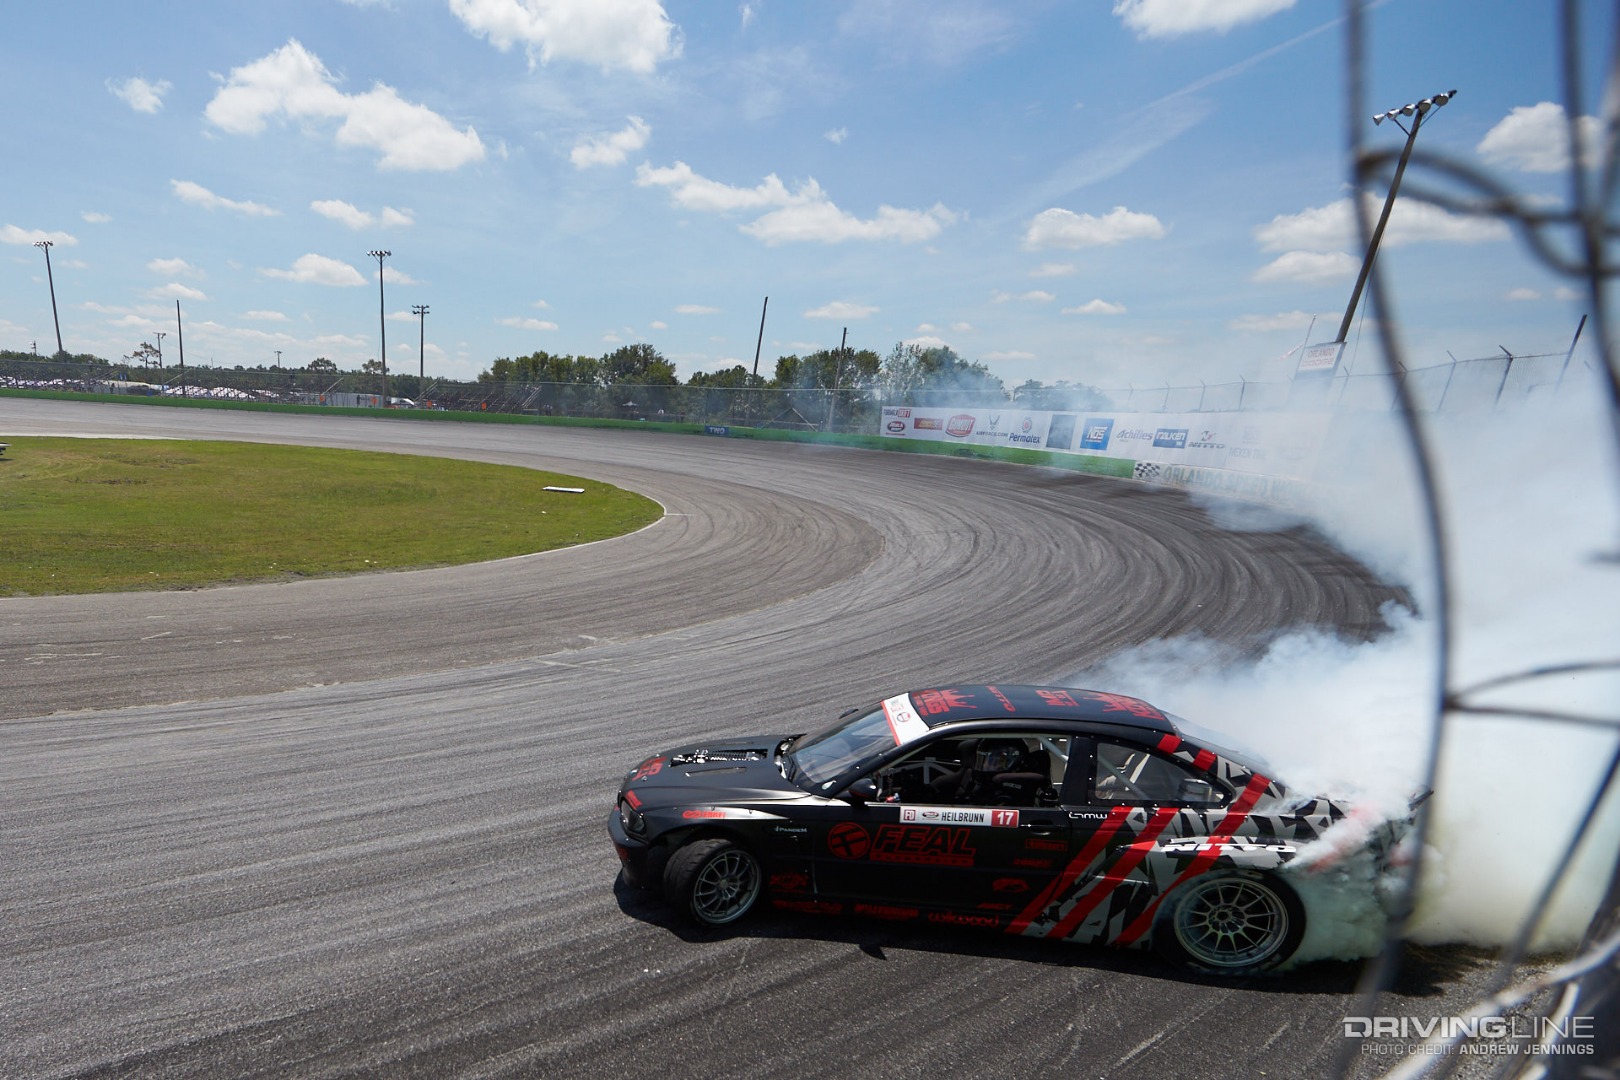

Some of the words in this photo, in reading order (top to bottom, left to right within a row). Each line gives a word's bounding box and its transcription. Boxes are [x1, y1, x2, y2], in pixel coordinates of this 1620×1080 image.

[709, 426, 725, 435] TWO
[1086, 426, 1107, 440] NOS
[1116, 429, 1153, 441] Achilles
[1155, 431, 1186, 441] FALKEN
[1009, 432, 1041, 444] Permatex
[1188, 441, 1226, 449] NITTO
[1162, 465, 1225, 492] ORLANDO
[941, 811, 985, 823] HEILBRUNN
[997, 811, 1014, 825] 17
[870, 823, 977, 857] FEAL
[1160, 843, 1297, 853] NITTO
